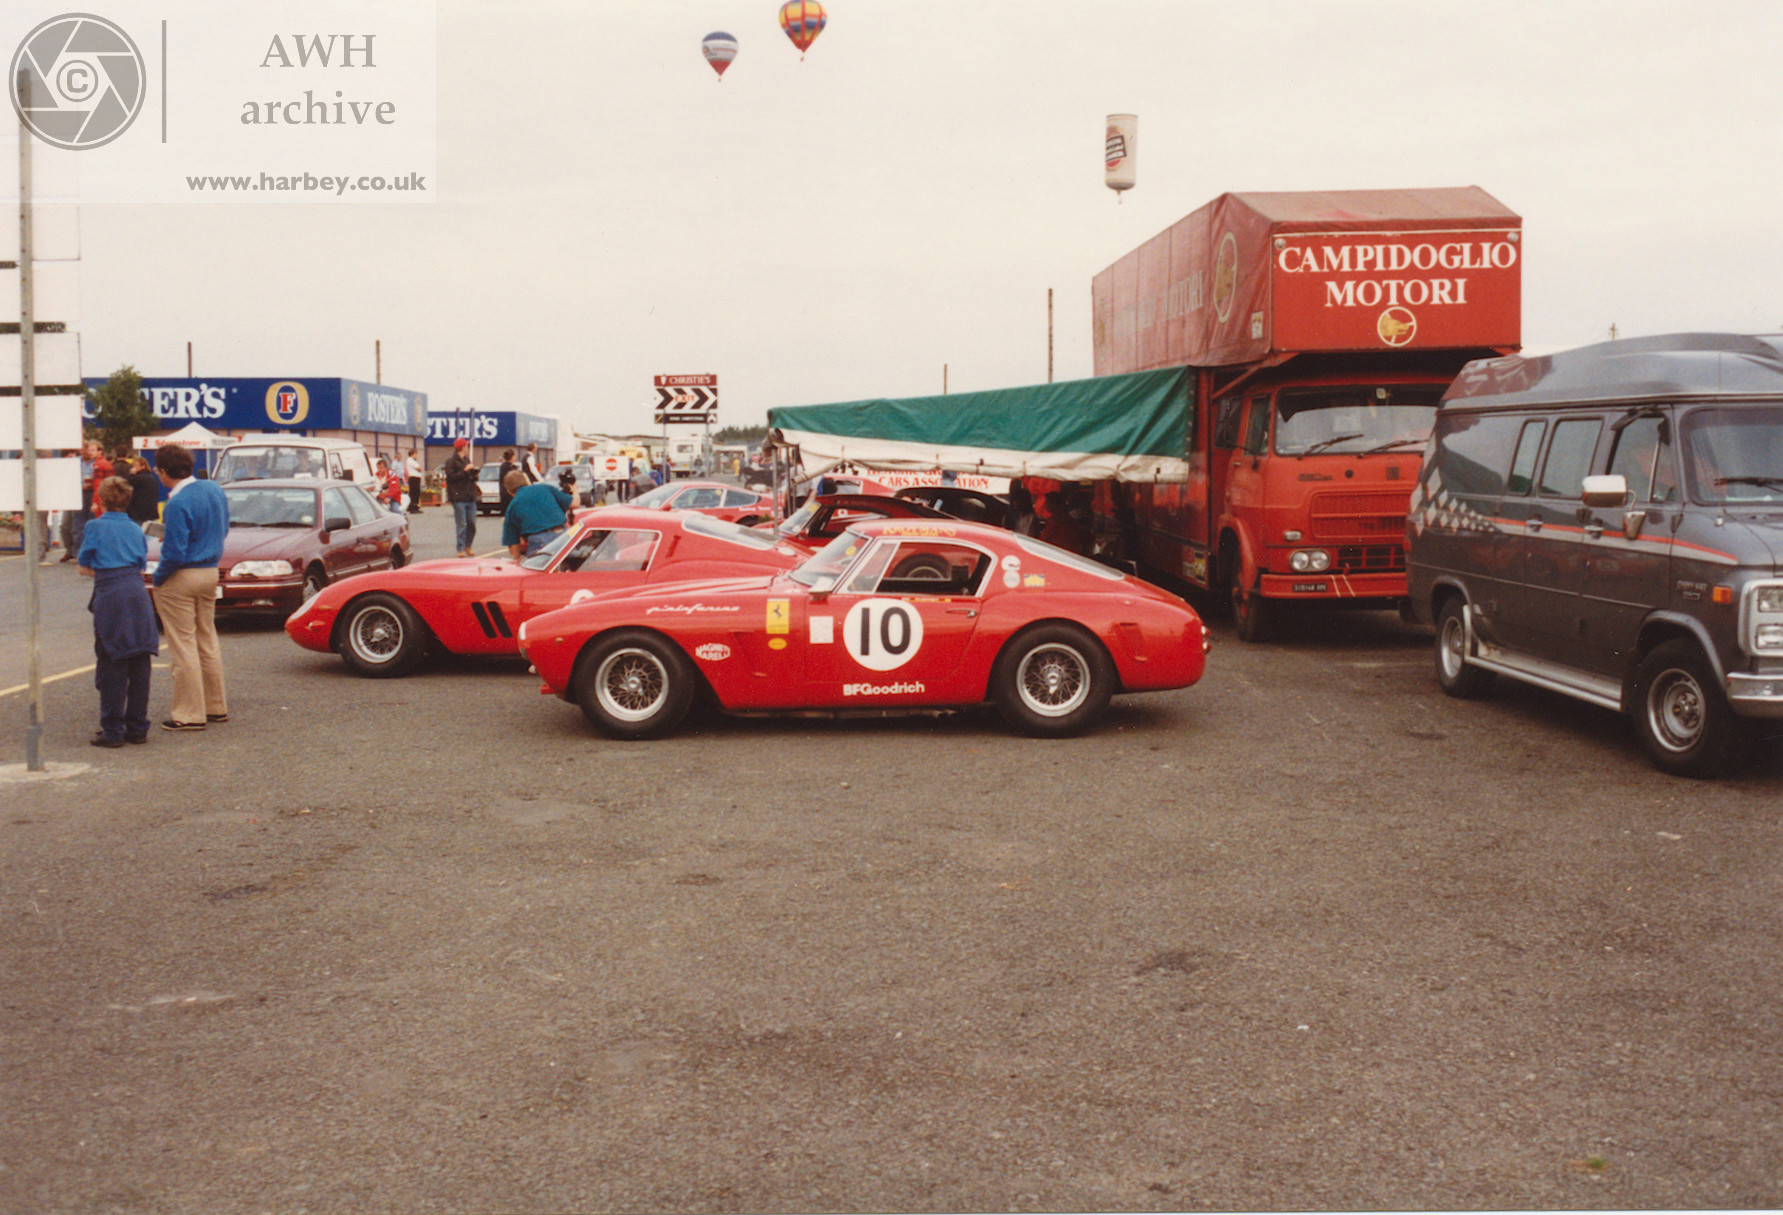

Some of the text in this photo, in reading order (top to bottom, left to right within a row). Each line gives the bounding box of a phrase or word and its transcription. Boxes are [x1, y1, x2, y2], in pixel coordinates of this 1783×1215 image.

[1278, 241, 1517, 273] CAMPIDOGLIO
[1324, 278, 1468, 308] MOTORI
[668, 376, 712, 385] CHRISTIE'S
[367, 392, 407, 425] FOSTER'S
[879, 476, 989, 489] CARS ASSOATION
[860, 606, 911, 656] 10
[843, 681, 925, 697] BFGoodrich
